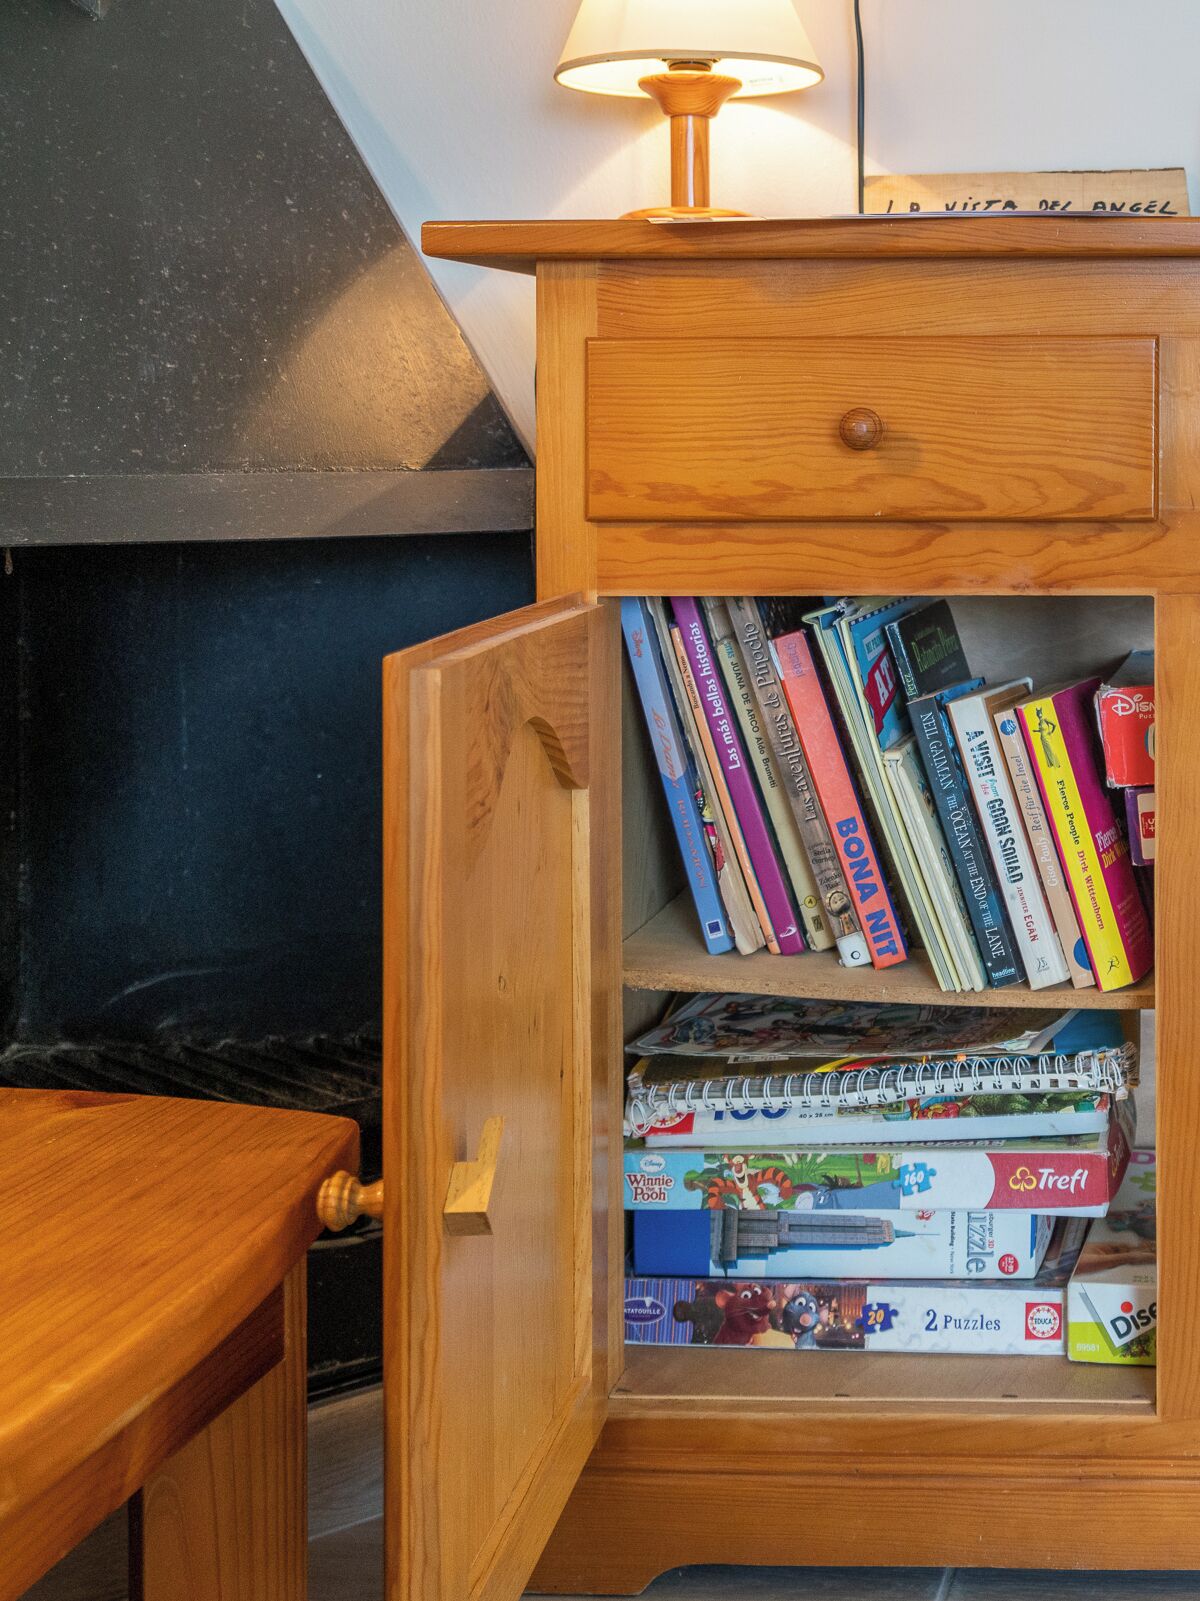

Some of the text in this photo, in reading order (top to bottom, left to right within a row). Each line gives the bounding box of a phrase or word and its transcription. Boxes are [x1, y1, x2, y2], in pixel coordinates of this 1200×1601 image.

[1039, 199, 1072, 212] DEL
[1092, 200, 1179, 215] ANGEL
[680, 655, 689, 674] Nemo
[685, 679, 700, 710] Buscando
[689, 621, 741, 770] Las más bellas historias
[730, 661, 745, 691] JUANA
[741, 692, 751, 706] DE
[746, 708, 760, 733] ARCO
[755, 736, 766, 755] Aldo
[762, 757, 778, 789] Brunetti
[743, 622, 818, 822] Las aventuras de Pinocho
[965, 730, 985, 743] A
[970, 740, 996, 778] VISIT
[1010, 755, 1042, 832] Reif für die Insel
[986, 798, 1013, 838] GOON
[920, 711, 1006, 959] NEIL GAIMAN THE OCEAN AT THE END OF THE LANE
[1095, 827, 1118, 852] Fierce
[1000, 836, 1024, 884] SQUAD
[1056, 779, 1106, 930] Fierce People Dirk Wittenborn
[1101, 848, 1117, 869] Dirk
[836, 816, 899, 957] BONA NIT
[1023, 914, 1039, 943] EGAN
[992, 966, 1016, 979] headline
[642, 1159, 664, 1169] Disney
[626, 1174, 673, 1187] Winnie
[904, 1171, 924, 1186] 160
[1038, 1168, 1089, 1194] Trefl
[633, 1186, 667, 1201] Pooh
[948, 1226, 956, 1248] Building
[966, 1211, 995, 1274] uzzle
[867, 1311, 885, 1326] 20
[924, 1308, 1001, 1332] 2 Puzzles
[1034, 1317, 1053, 1326] EDUCA
[1110, 1301, 1157, 1339] Dise
